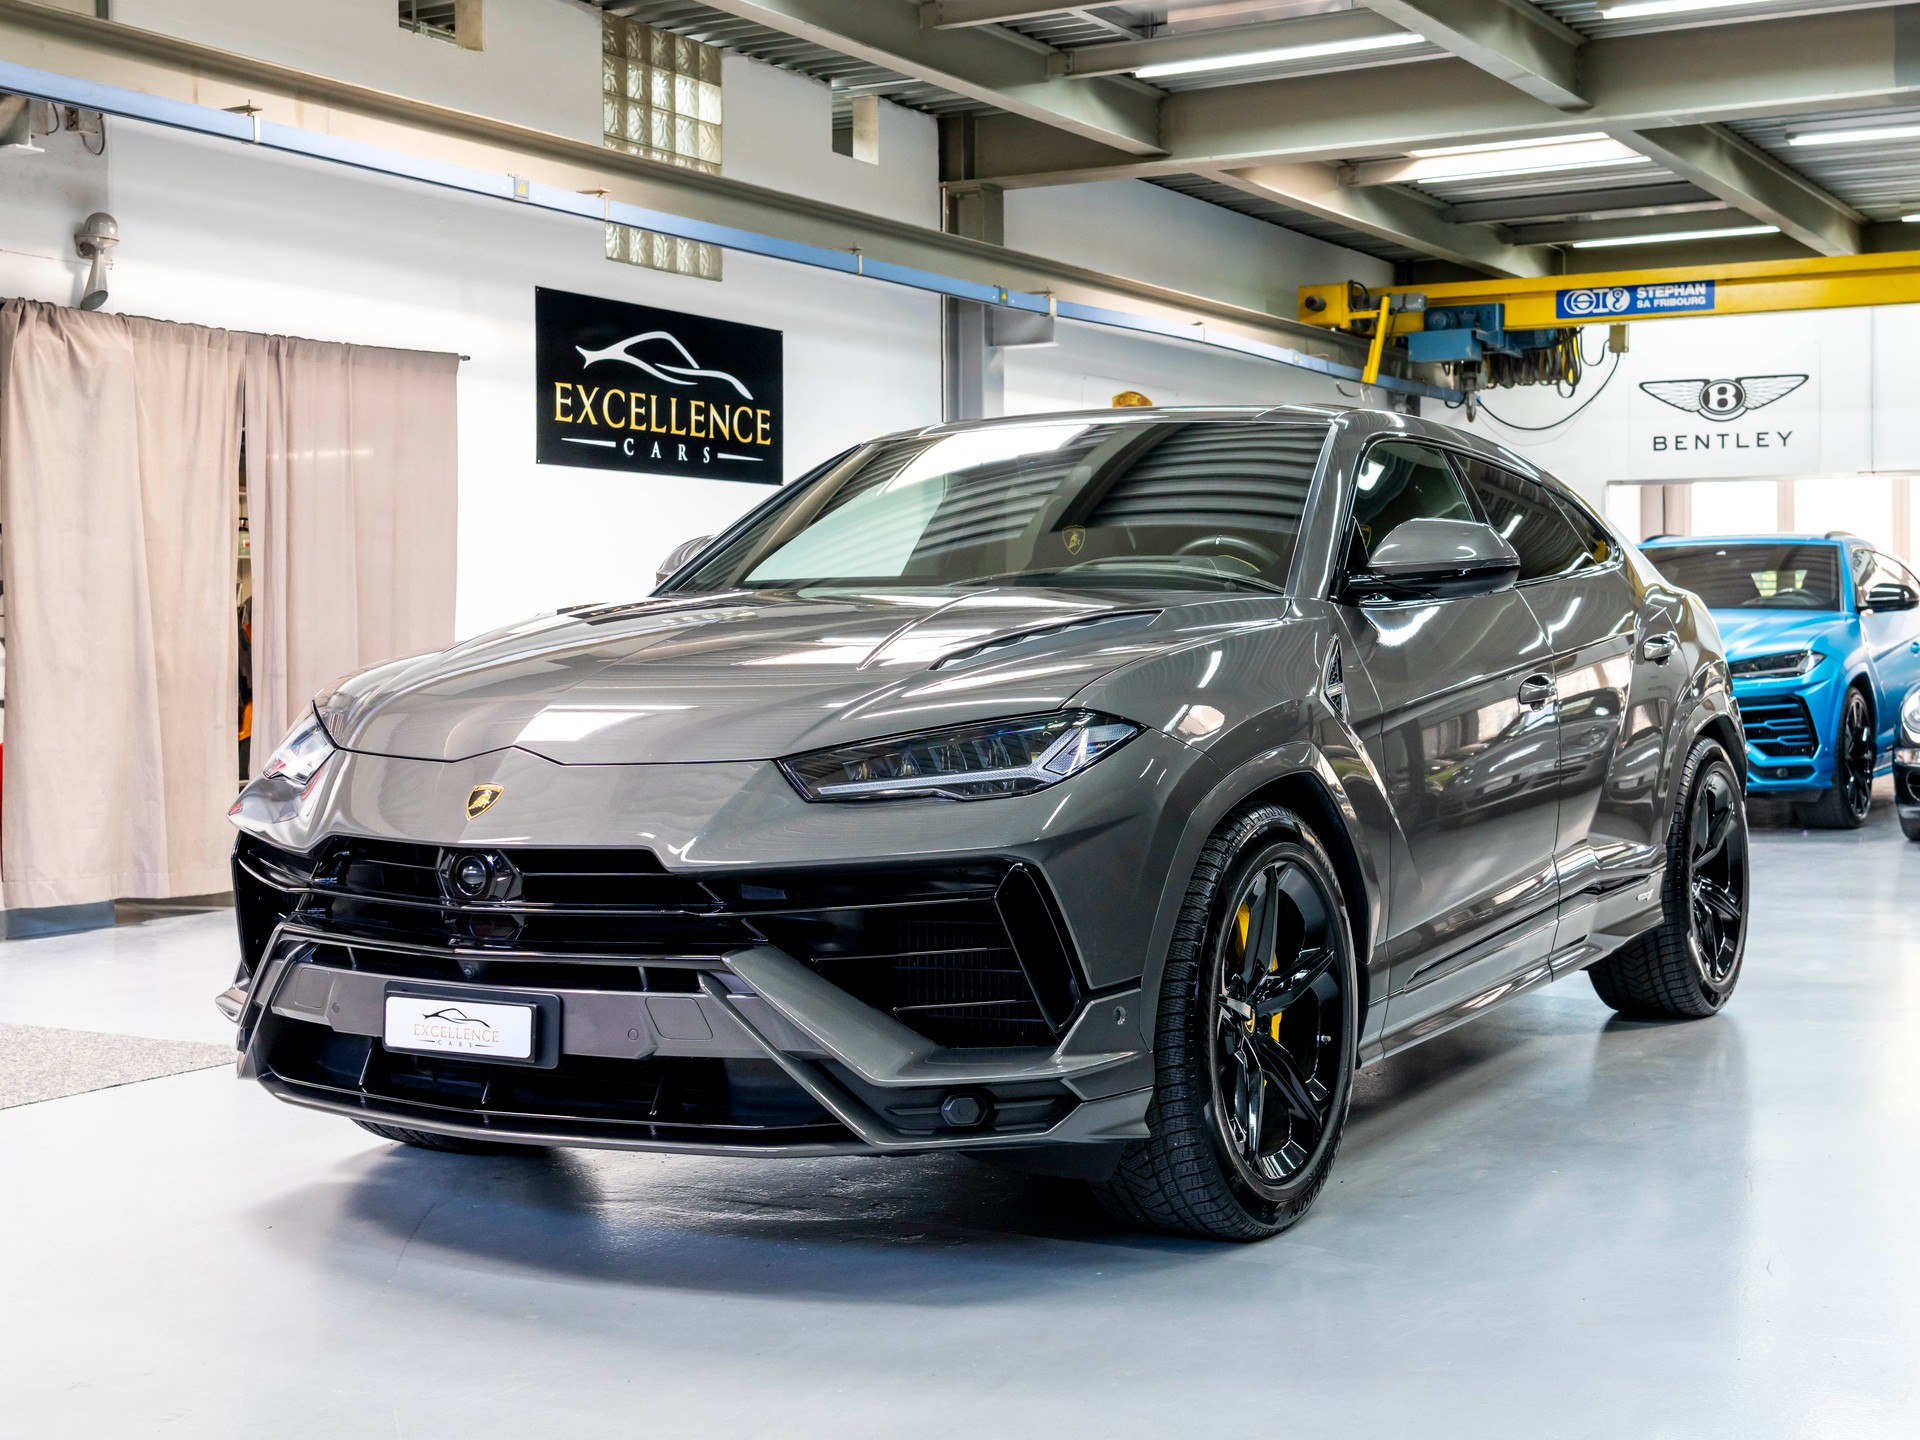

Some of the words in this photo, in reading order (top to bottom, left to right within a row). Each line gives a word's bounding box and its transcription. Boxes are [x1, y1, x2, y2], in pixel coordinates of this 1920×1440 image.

[1636, 283, 1706, 298] STEPHAN
[1636, 300, 1651, 309] SA
[1653, 296, 1706, 308] FRIBOURG
[1708, 382, 1737, 412] B
[554, 381, 772, 446] EXCELLENCE
[623, 438, 711, 463] CARS
[1653, 431, 1793, 451] BENTLEY
[413, 1024, 499, 1043] EXCELLENCE
[438, 1040, 472, 1048] CARS
